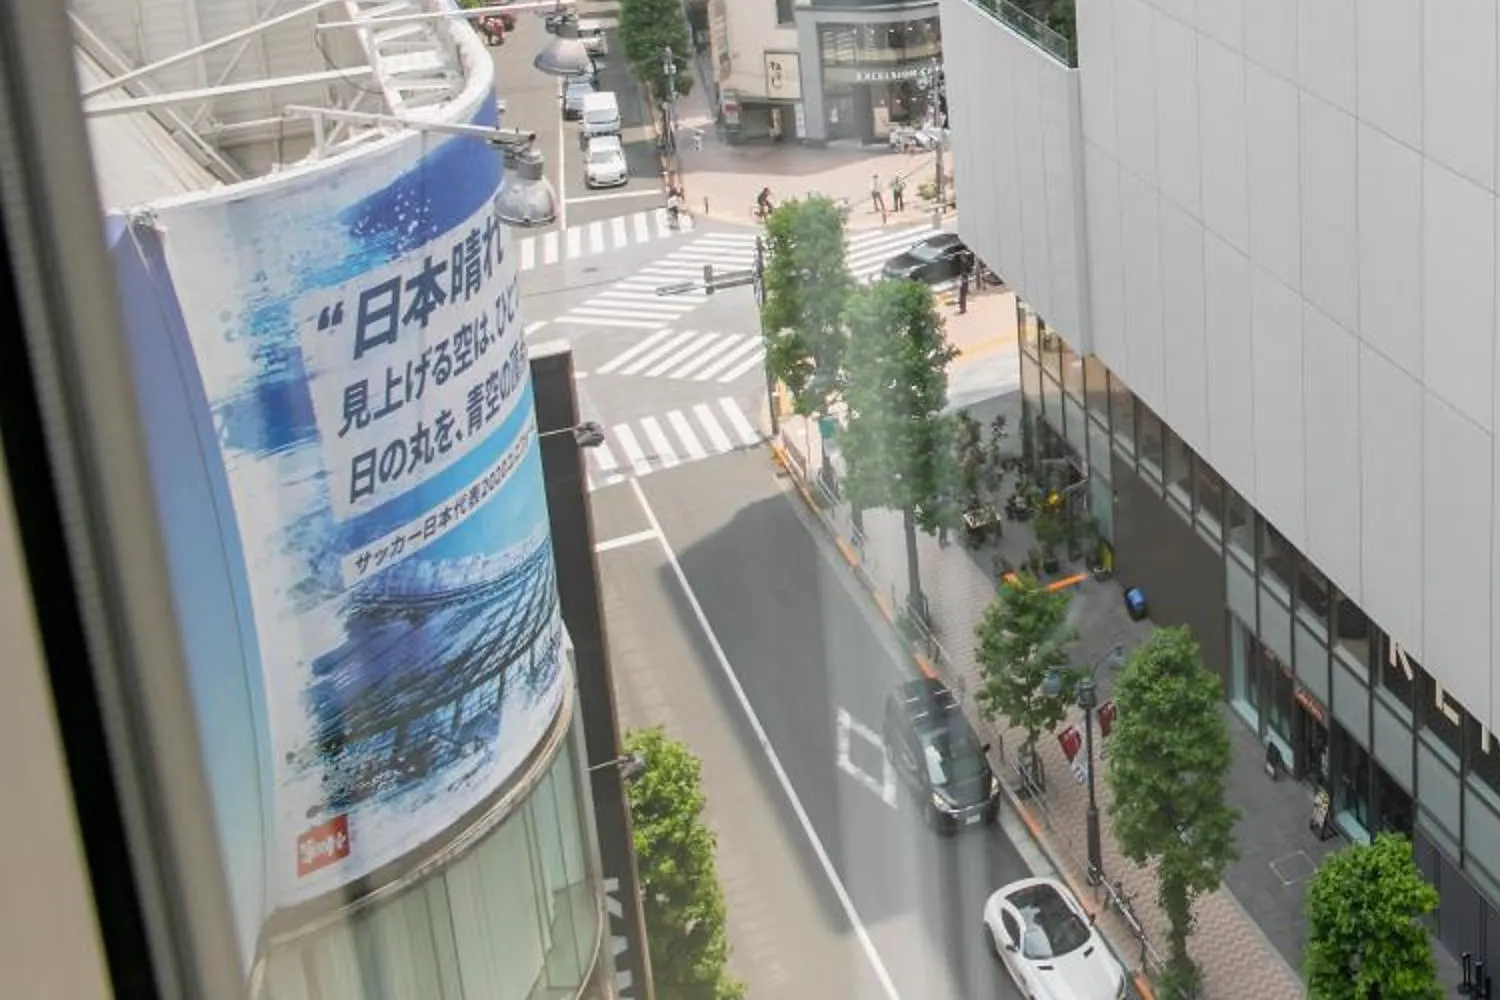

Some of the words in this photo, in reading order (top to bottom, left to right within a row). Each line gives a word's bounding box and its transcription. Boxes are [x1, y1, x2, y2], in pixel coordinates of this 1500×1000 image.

[338, 274, 519, 439] 見上げる空は、ひと
